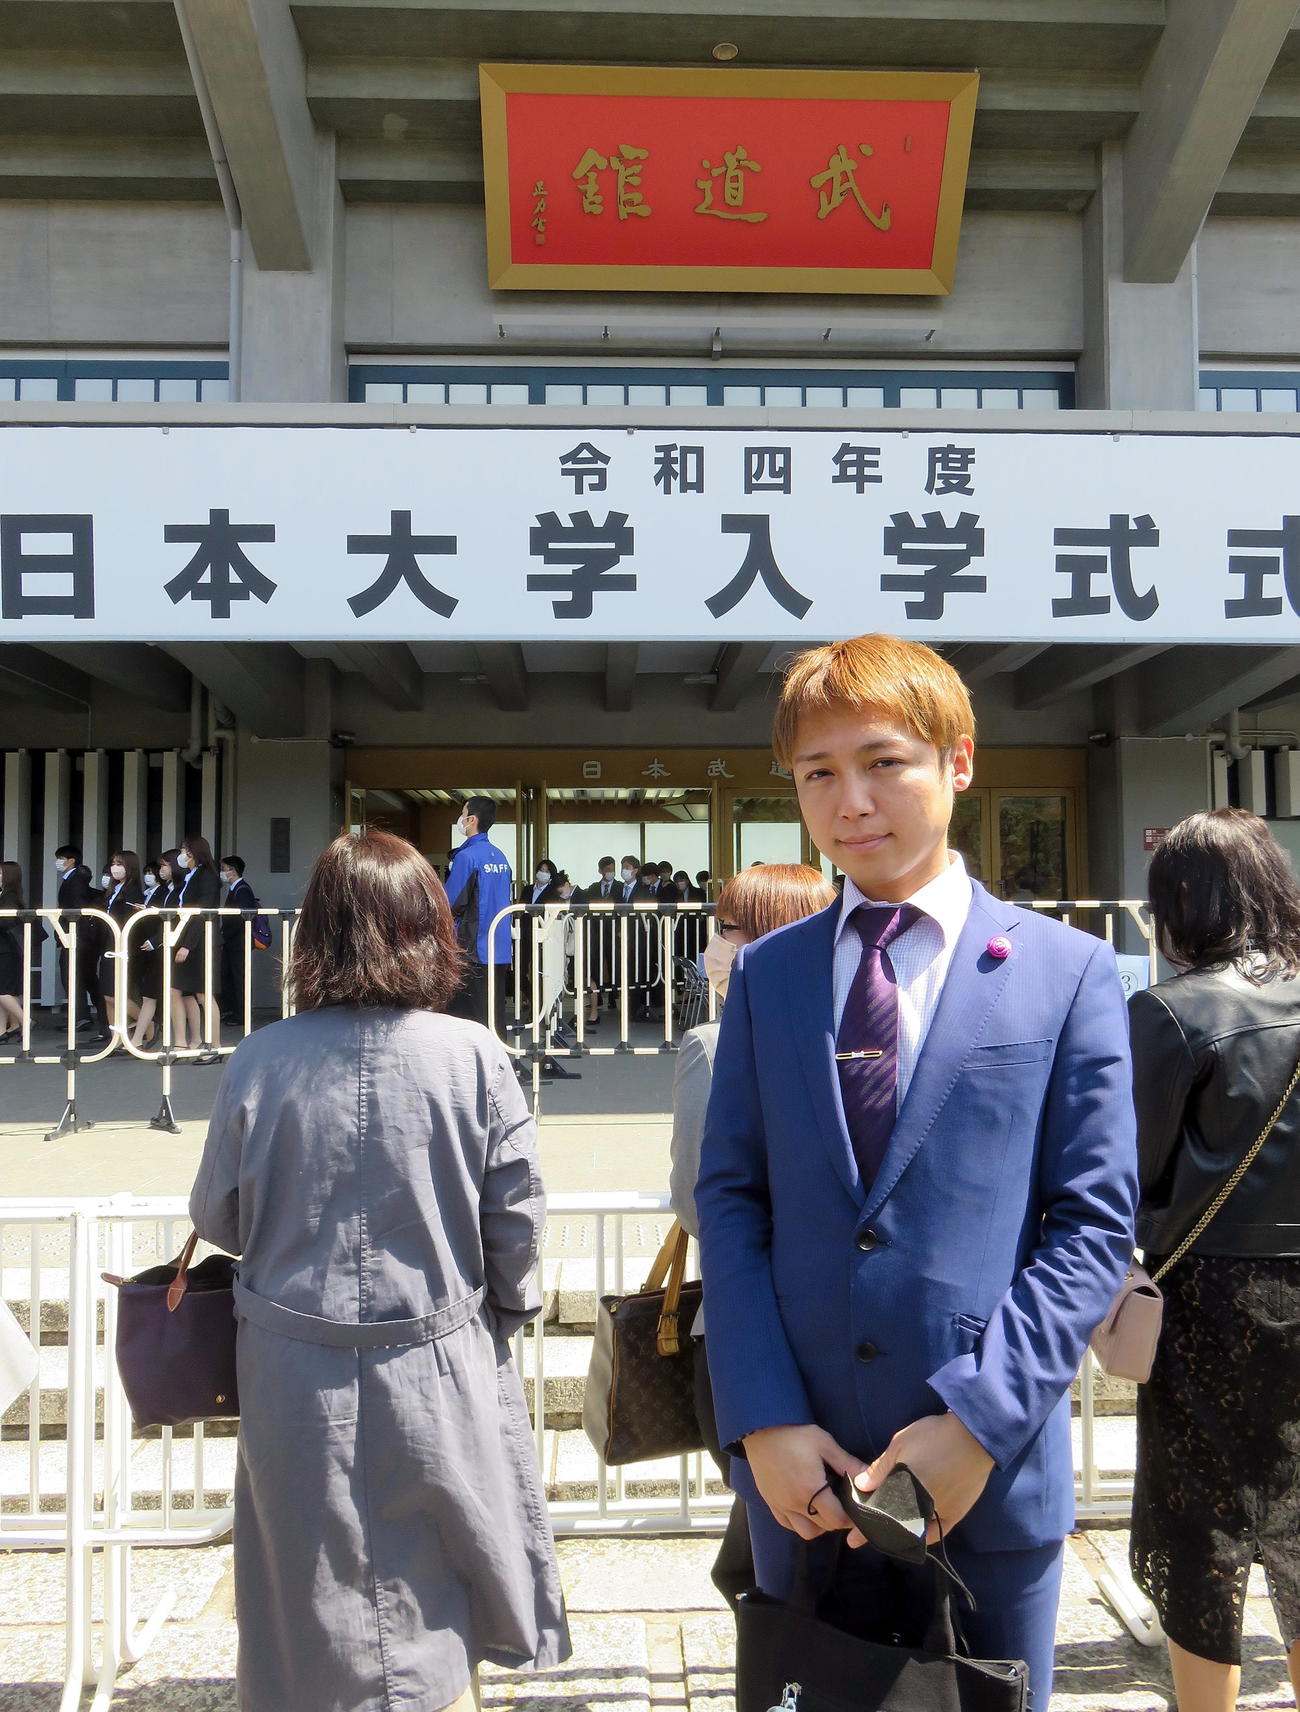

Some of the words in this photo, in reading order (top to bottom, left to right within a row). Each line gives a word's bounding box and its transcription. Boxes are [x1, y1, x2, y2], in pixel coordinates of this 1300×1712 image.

[559, 442, 977, 496] 令和四年度
[483, 863, 508, 873] STAFF
